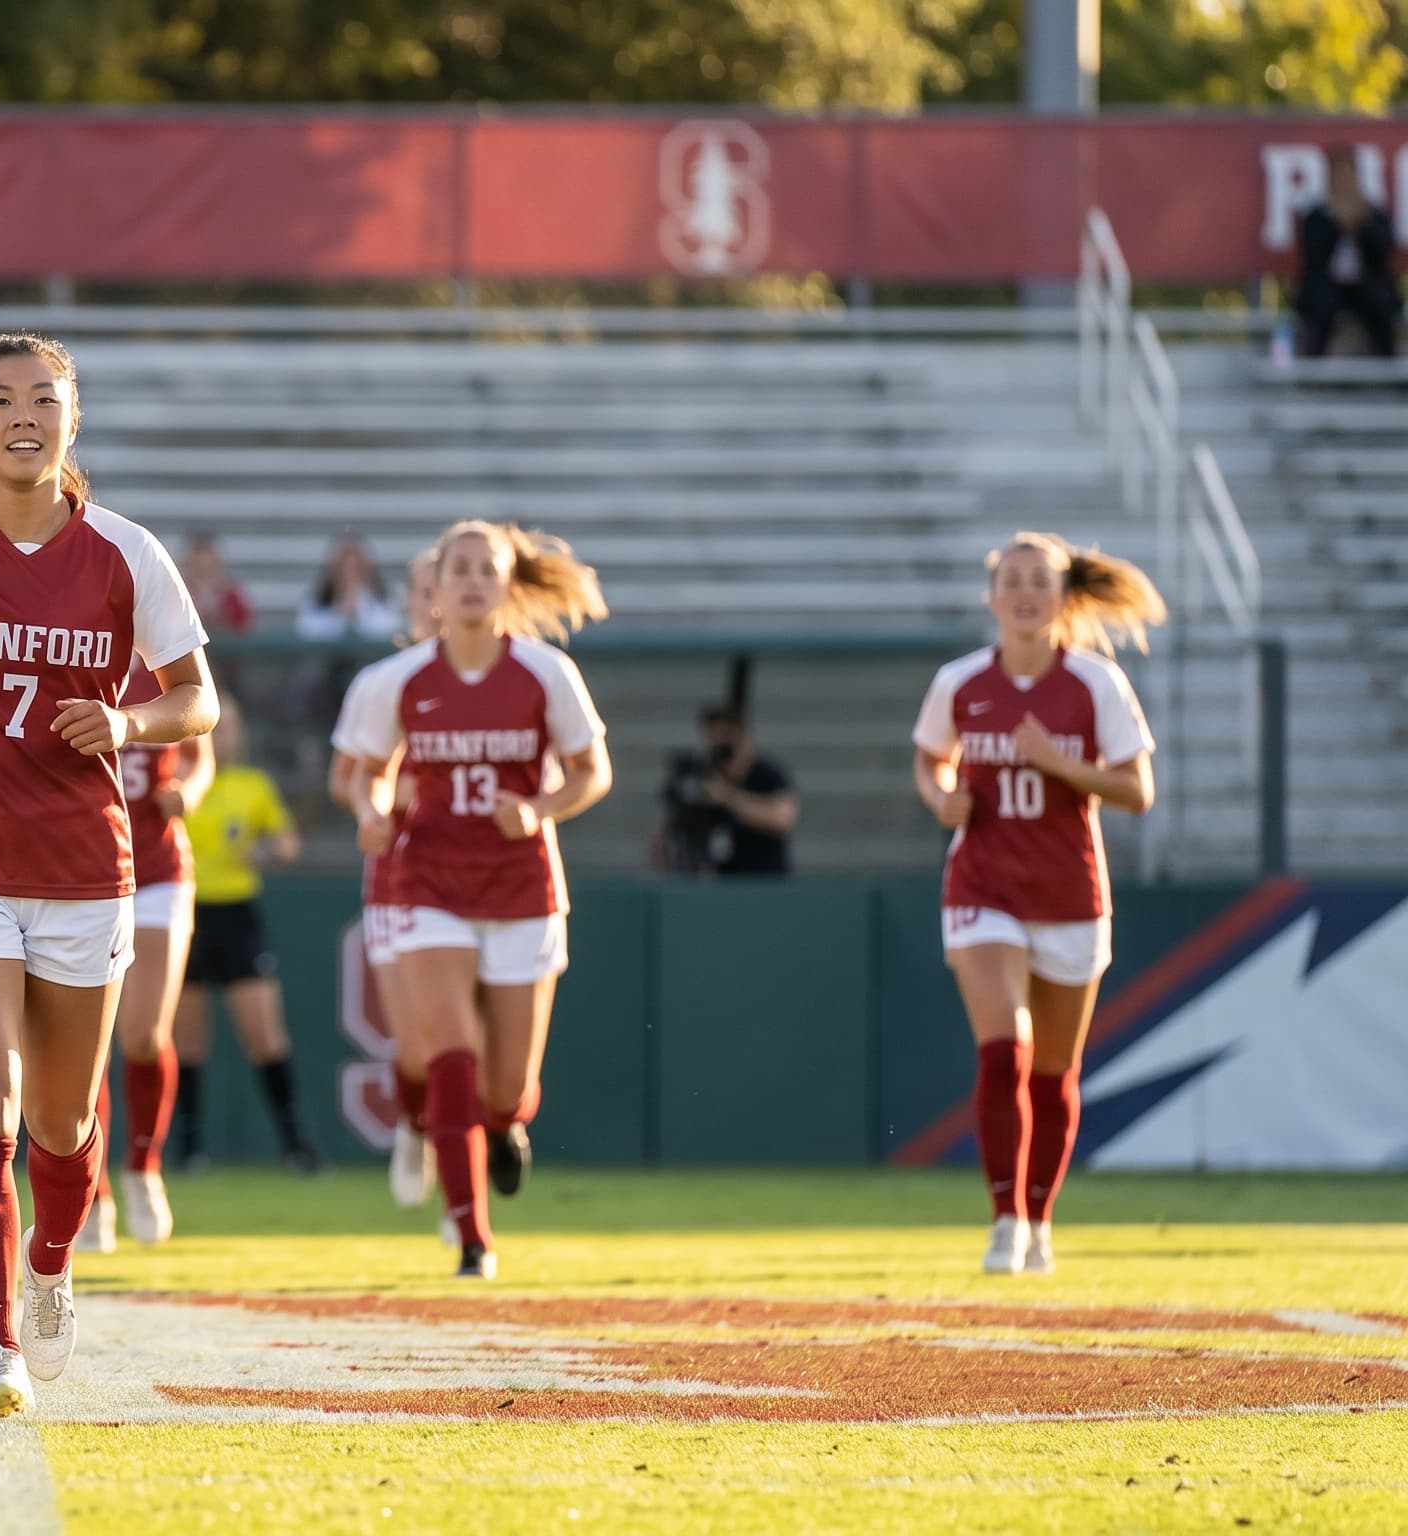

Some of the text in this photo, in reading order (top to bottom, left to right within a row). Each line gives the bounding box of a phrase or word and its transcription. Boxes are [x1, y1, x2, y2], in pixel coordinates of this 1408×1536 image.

[2, 673, 40, 739] 7
[450, 763, 498, 816] 13
[996, 766, 1045, 819] 10
